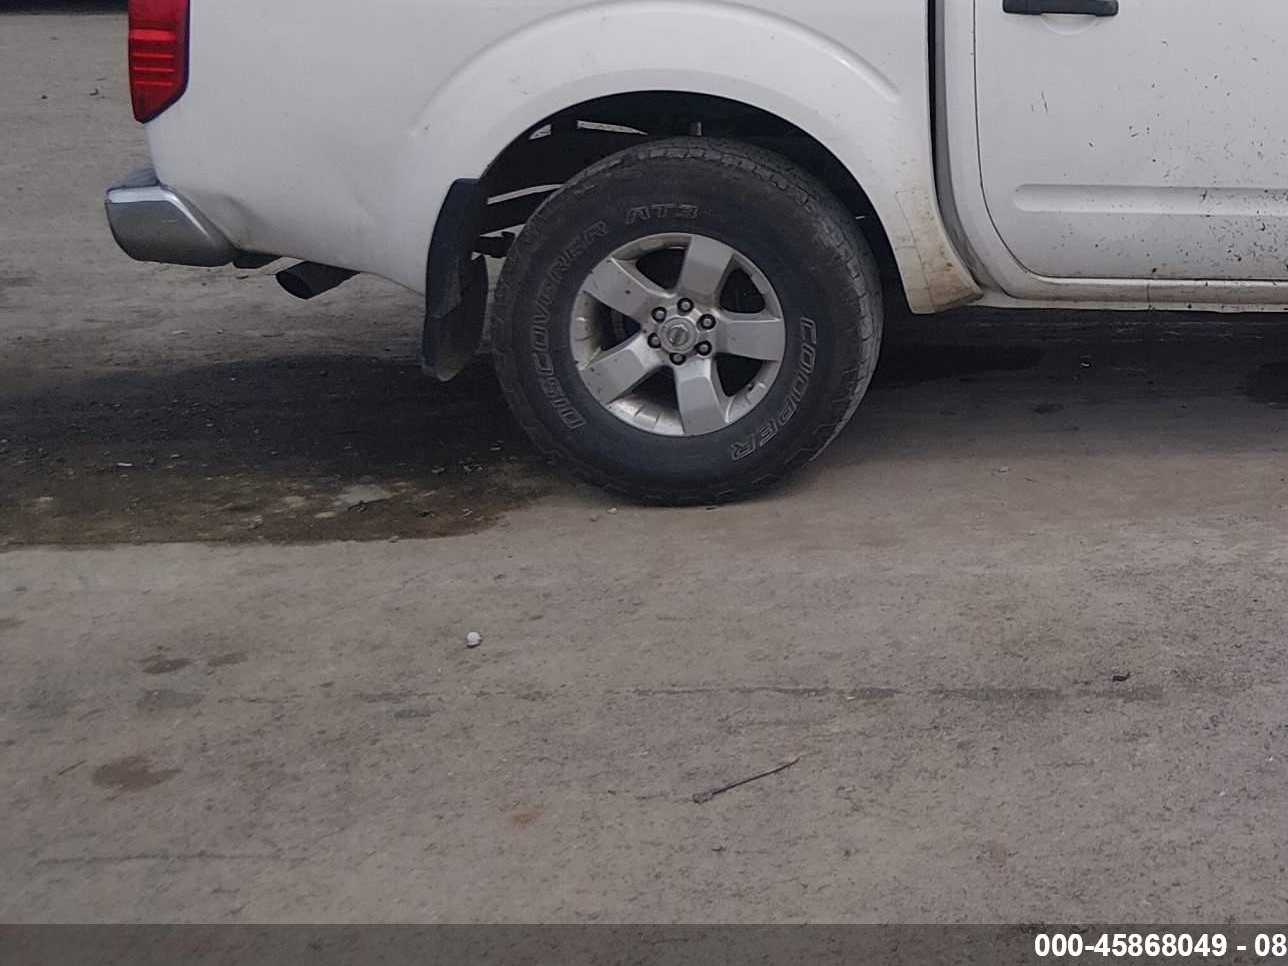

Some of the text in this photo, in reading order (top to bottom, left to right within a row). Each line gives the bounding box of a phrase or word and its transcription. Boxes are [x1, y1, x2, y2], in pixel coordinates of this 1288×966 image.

[528, 201, 700, 431] DISCOVERER AT3
[729, 316, 818, 462] COOPER
